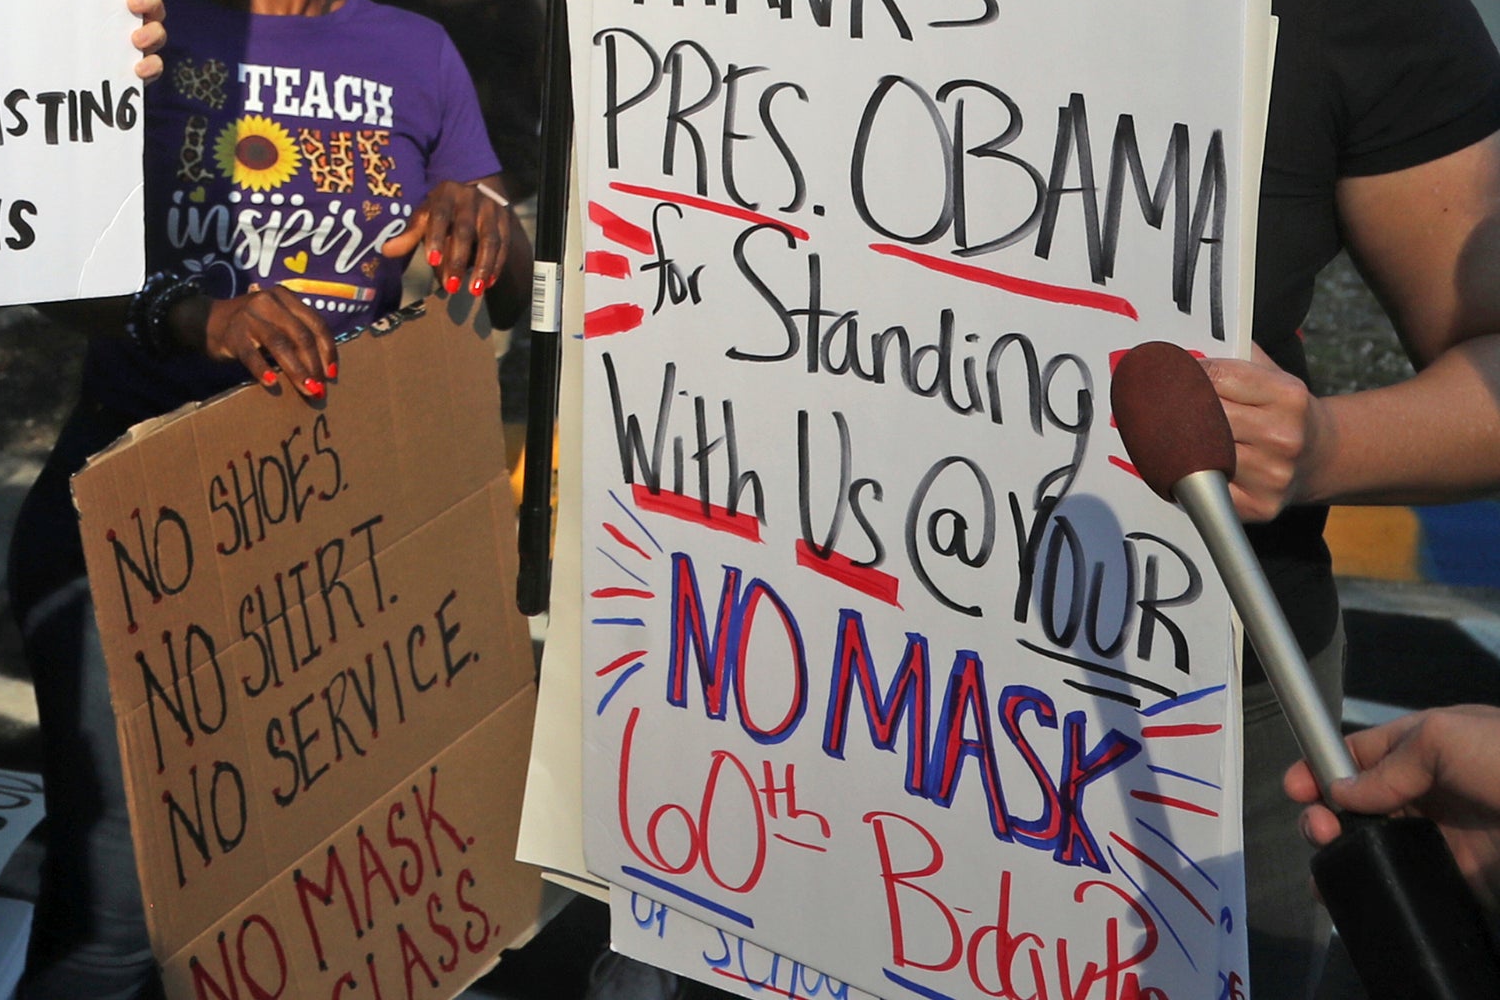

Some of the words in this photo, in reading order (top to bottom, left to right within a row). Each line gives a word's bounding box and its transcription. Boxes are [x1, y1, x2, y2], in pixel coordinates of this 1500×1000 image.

[238, 62, 394, 128] TEACH
[593, 28, 825, 217] PRES.
[851, 74, 1228, 342] OBAMA
[602, 352, 766, 525] With
[798, 410, 884, 567] Us
[640, 203, 706, 316] for
[726, 224, 1094, 503] Standing
[106, 506, 194, 633] NO
[209, 413, 349, 556] SHOES.
[134, 623, 228, 774] NO
[239, 514, 398, 699] SHIRT.
[161, 761, 247, 887] NO
[266, 589, 480, 807] SERVICE.
[667, 552, 808, 746] NO
[822, 607, 1143, 874] MASK
[189, 914, 287, 1000] NO
[292, 766, 474, 972] MASK.
